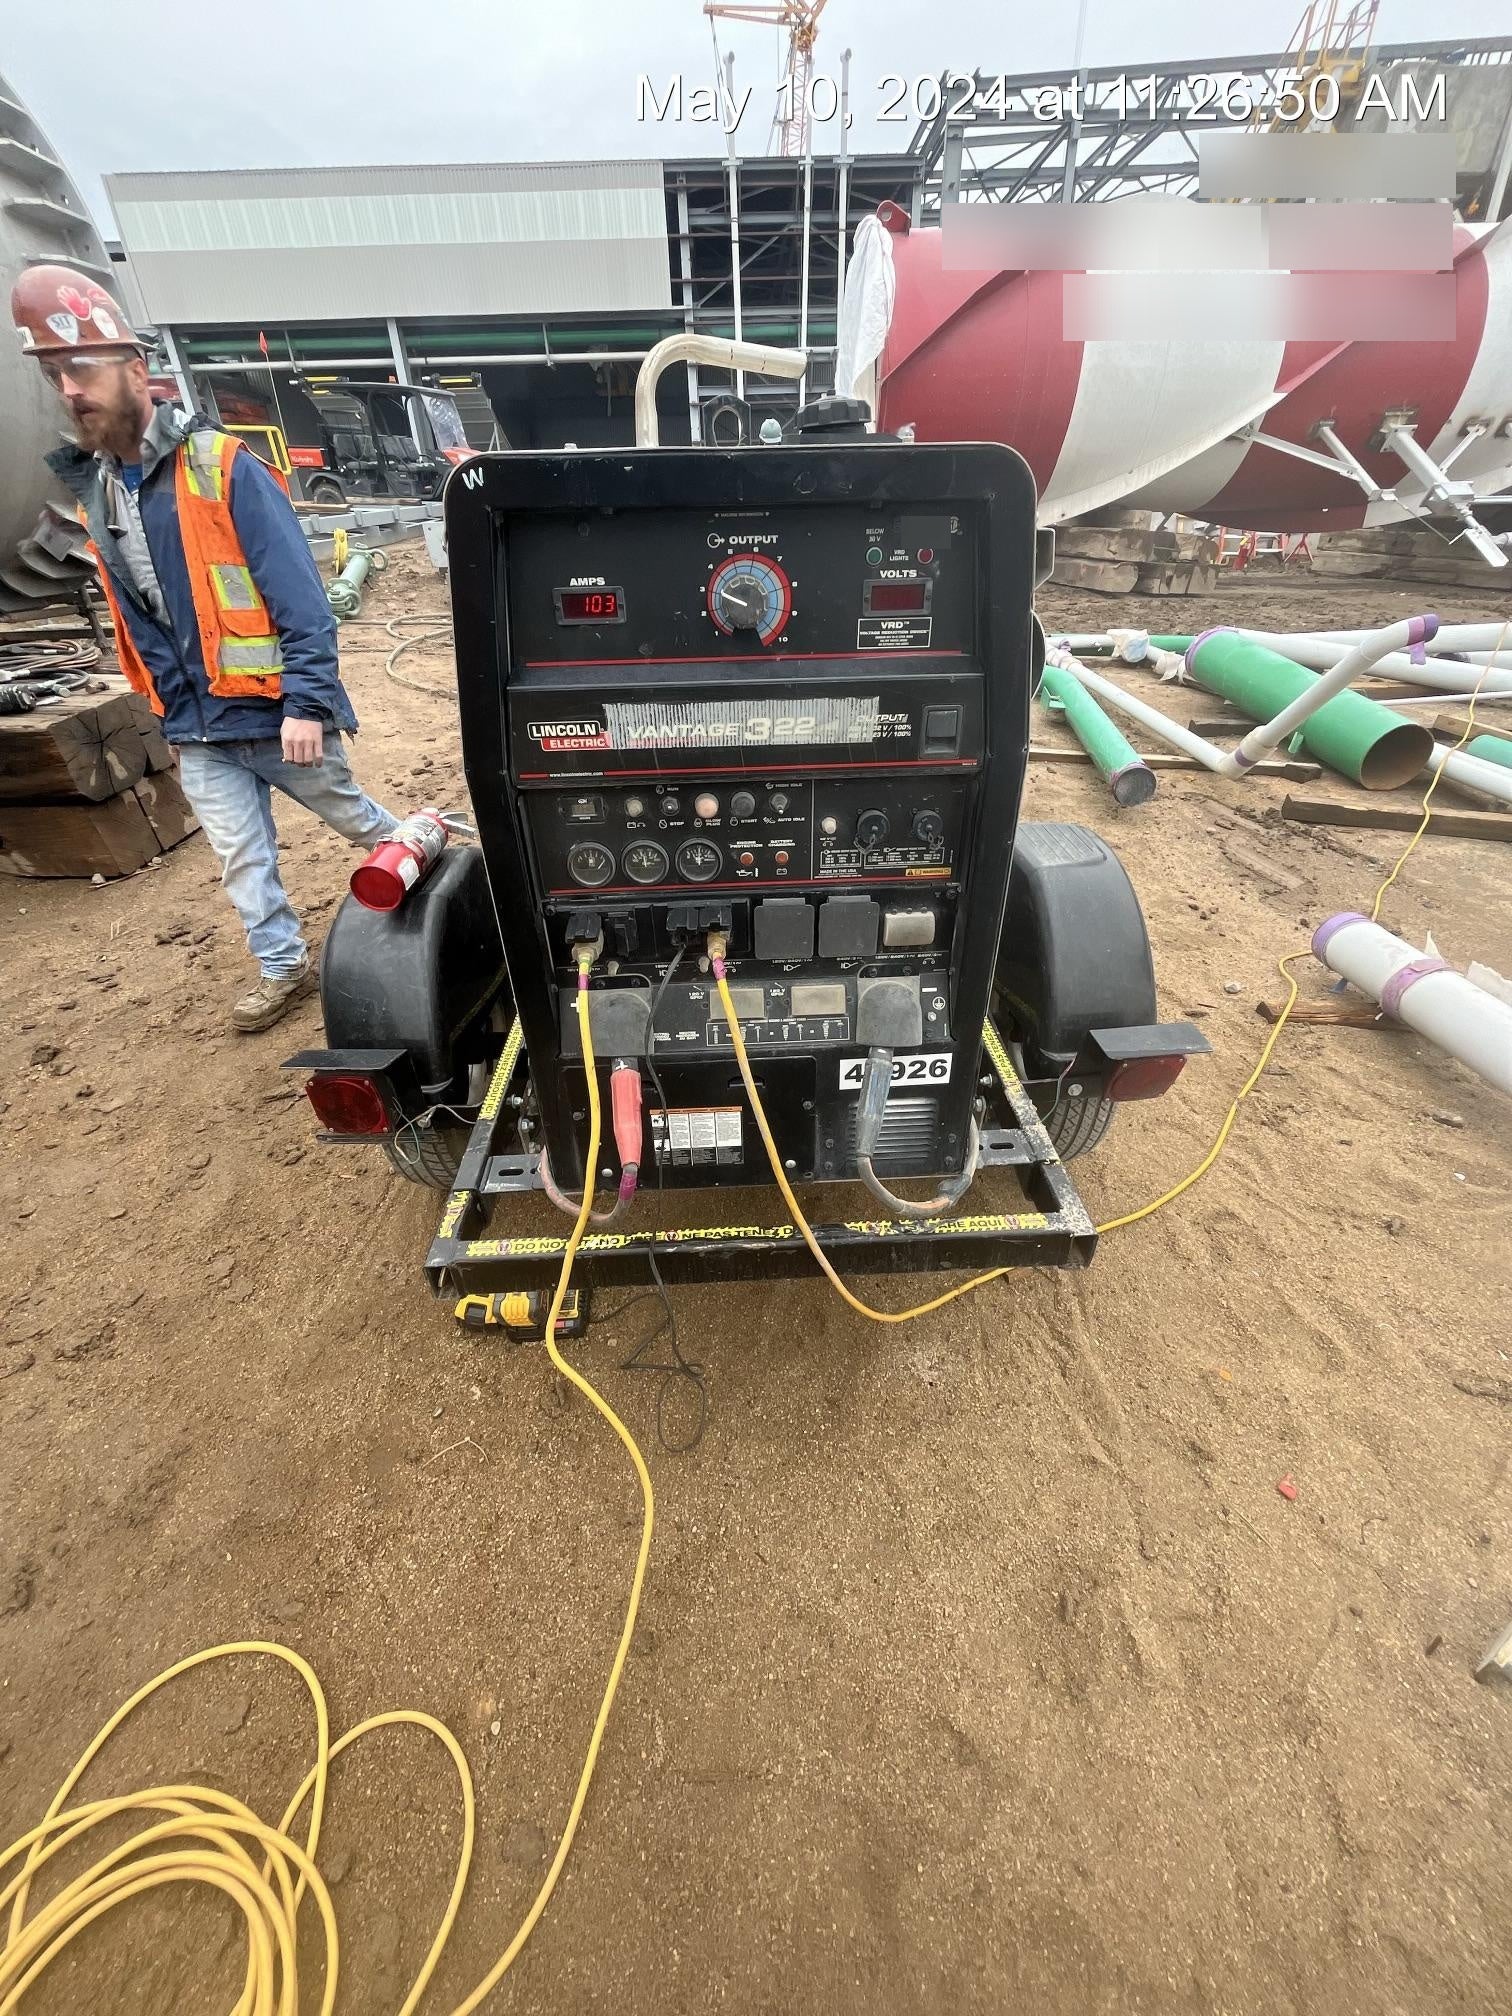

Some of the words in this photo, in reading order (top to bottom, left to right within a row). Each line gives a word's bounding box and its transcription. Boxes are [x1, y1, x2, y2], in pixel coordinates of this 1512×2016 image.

[728, 535, 779, 545] OUTPUT
[879, 569, 917, 578] VOLTS
[569, 577, 606, 586] AMPS
[585, 595, 615, 613] 103
[532, 724, 597, 737] LINCOLN
[626, 723, 741, 739] VANTAGE
[744, 716, 816, 741] 322
[549, 738, 606, 749] ELECTRIC
[844, 1058, 948, 1083] 4926
[491, 1072, 505, 1102] DEBOUT
[968, 1219, 1002, 1228] AQUI
[514, 1242, 536, 1250] DO
[539, 1240, 568, 1249] NOT
